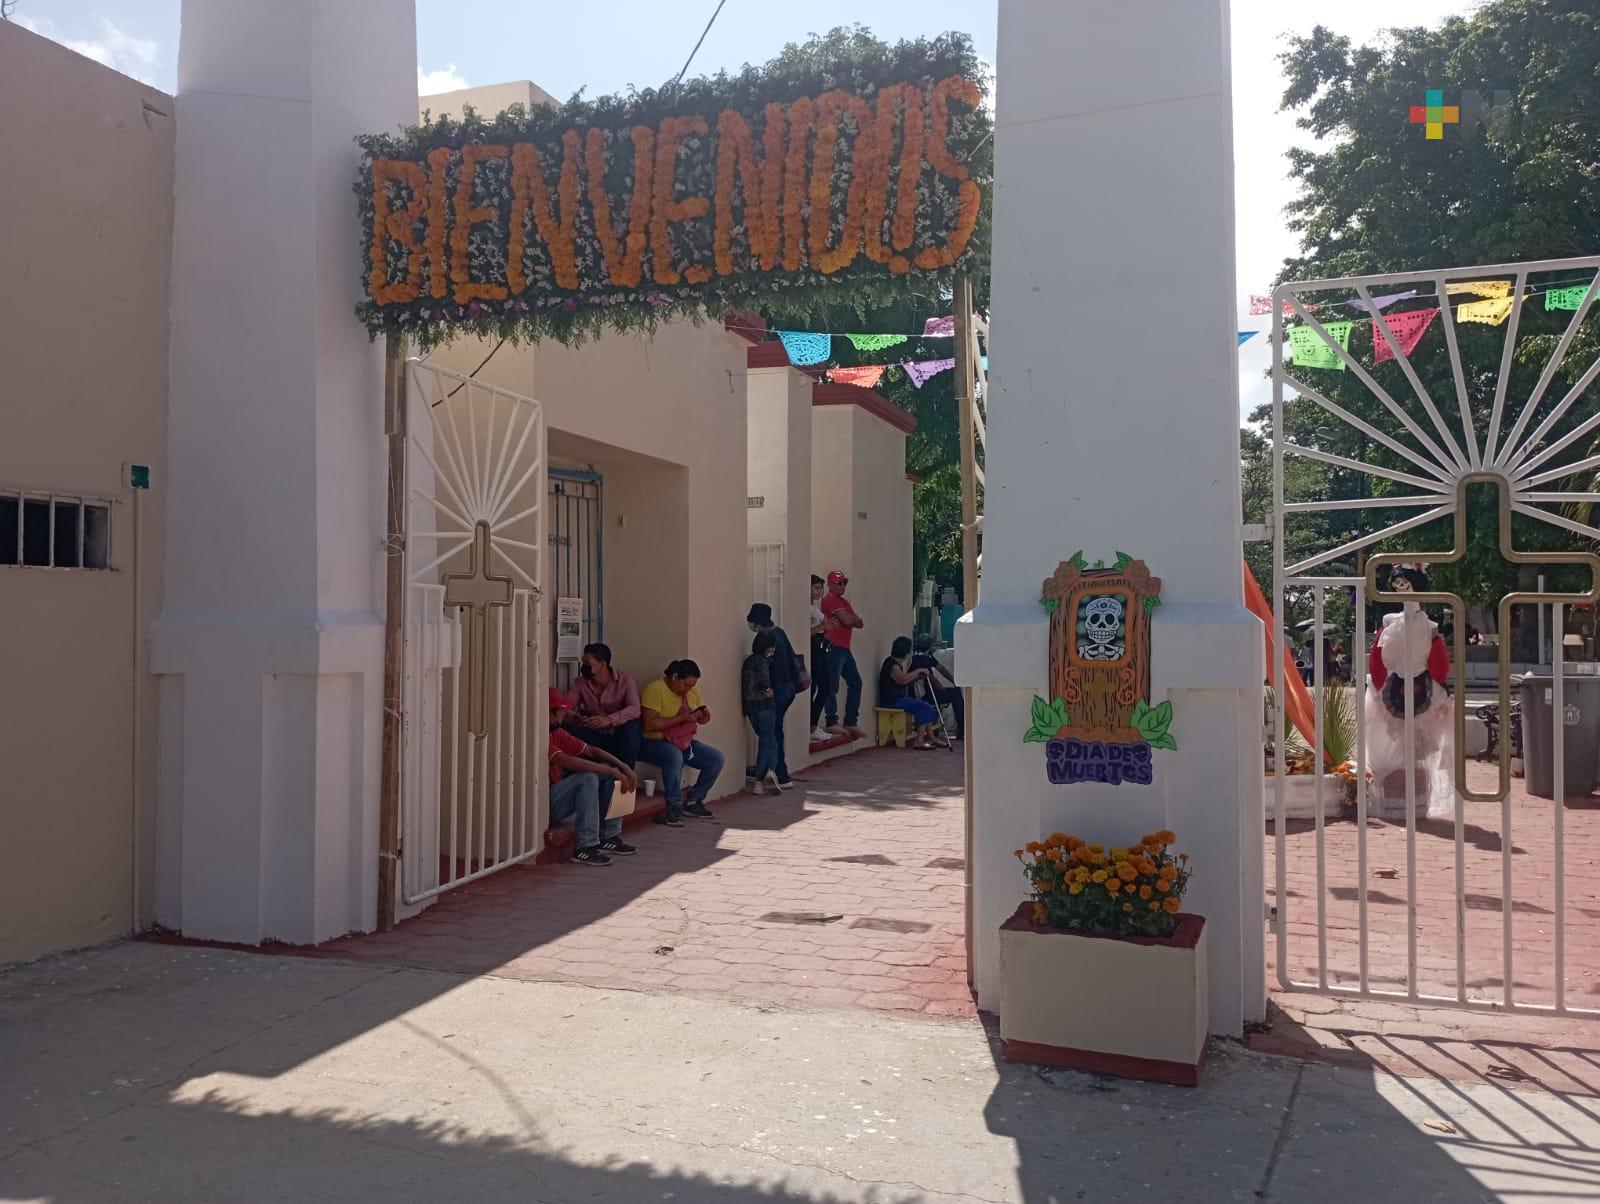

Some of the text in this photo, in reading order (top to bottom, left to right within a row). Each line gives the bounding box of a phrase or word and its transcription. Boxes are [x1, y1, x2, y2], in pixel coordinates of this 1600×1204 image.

[369, 75, 981, 304] BIENVENIDOS
[1065, 741, 1132, 761] DIA DE
[1049, 760, 1150, 784] MUERTOS
